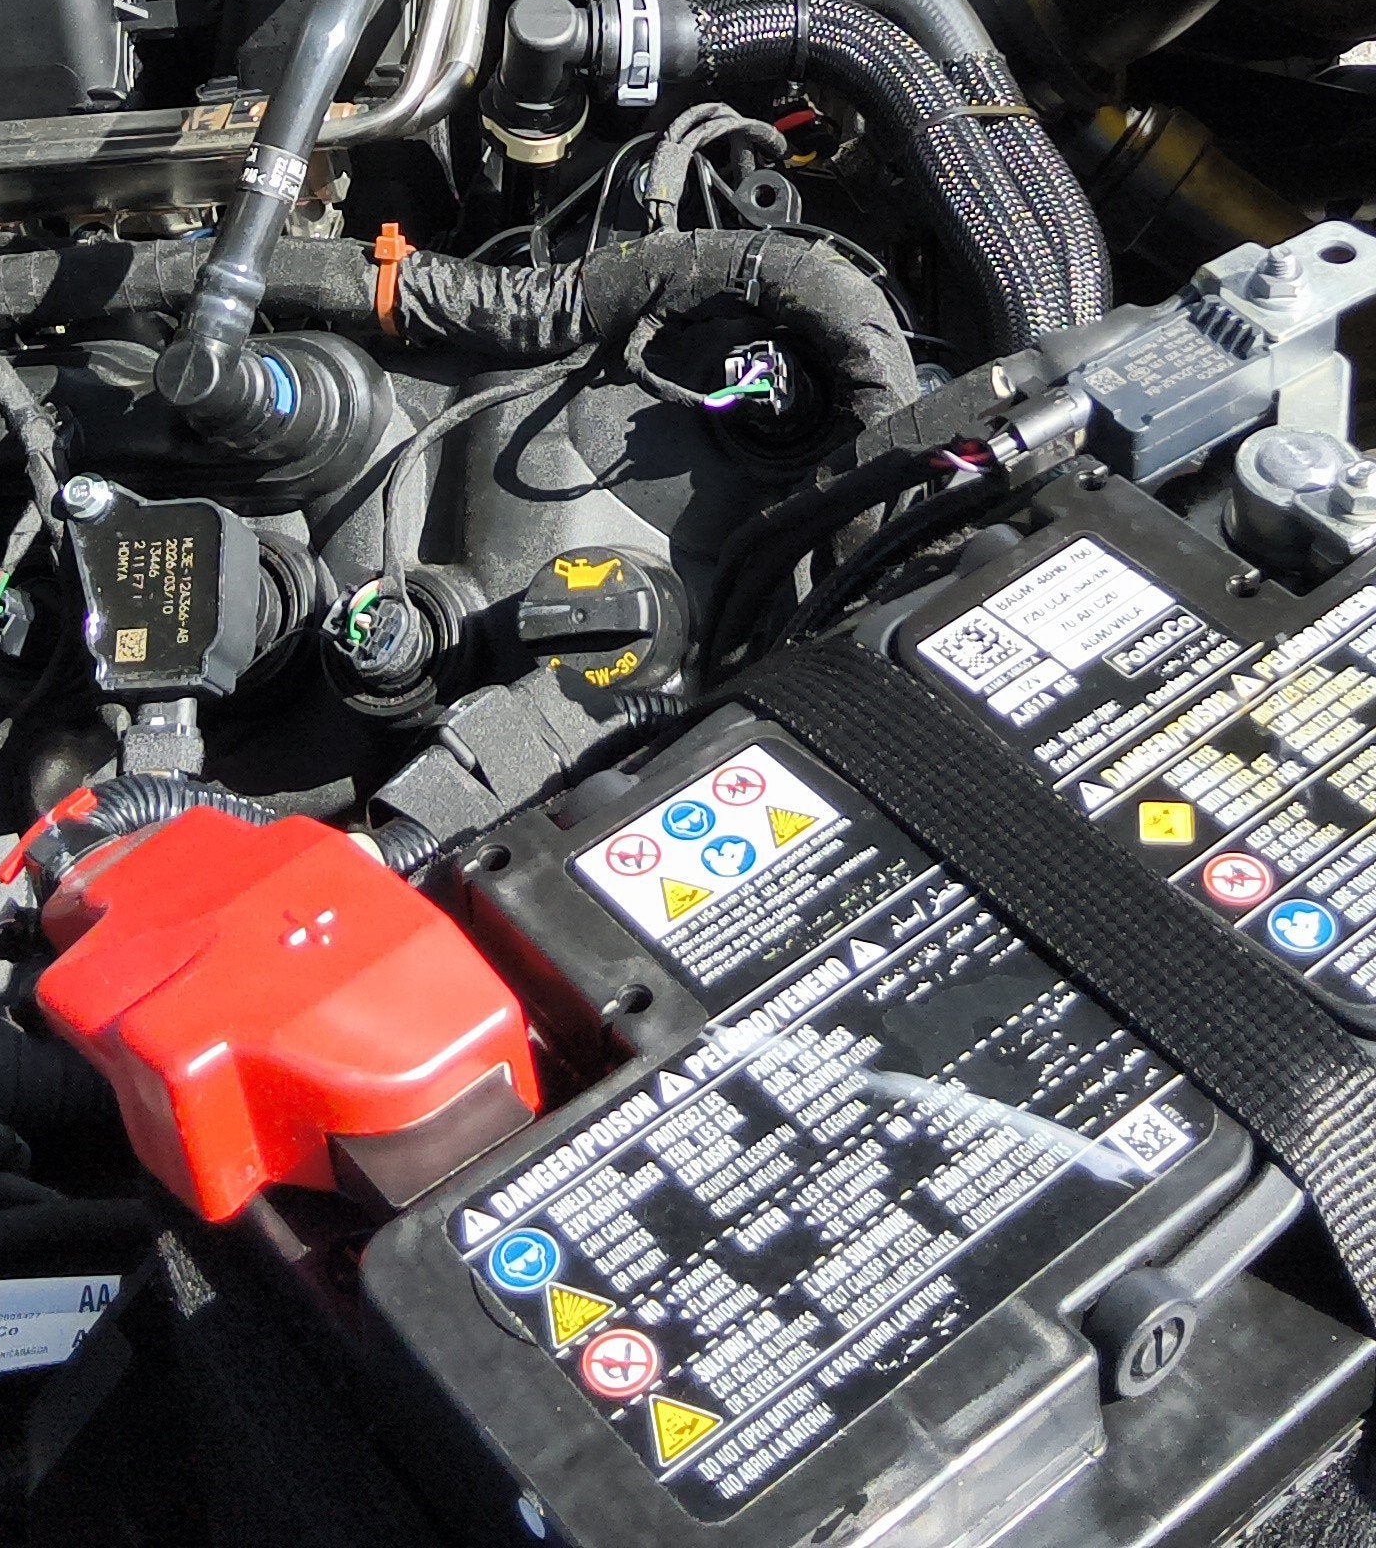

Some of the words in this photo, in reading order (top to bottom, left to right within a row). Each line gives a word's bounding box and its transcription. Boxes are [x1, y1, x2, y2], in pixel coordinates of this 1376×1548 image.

[1112, 608, 1198, 674] FoMoCo
[1007, 689, 1057, 727] AJ61A
[1052, 673, 1082, 696] MF
[1048, 749, 1082, 774] Ford
[1071, 729, 1110, 758] Motor
[1097, 688, 1241, 790] DANGER/POISON
[1354, 774, 1376, 790] LA
[1244, 824, 1277, 849] KEEP
[1267, 810, 1296, 831] OUT
[1286, 801, 1309, 817] OF
[1260, 841, 1287, 861] THE
[1276, 855, 1300, 873] OF
[1305, 867, 1340, 894] READ
[1329, 854, 1358, 875] ALL
[696, 904, 721, 923] USA
[1325, 885, 1358, 910] LIRE
[680, 954, 855, 1081] PELIGRO/VENENO
[789, 1023, 821, 1049] LOS
[775, 1057, 848, 1112] EXPLOSIVOS
[837, 1034, 882, 1068] PUEDEN
[790, 1048, 821, 1074] LOS
[809, 1023, 855, 1059] GASES
[692, 1120, 723, 1146] LES
[712, 1103, 746, 1131] GAZ
[697, 1090, 728, 1115] LES
[793, 1091, 839, 1128] CAUSAR
[883, 1114, 915, 1140] NO
[486, 1089, 664, 1220] DANGER/POISON
[674, 1133, 743, 1186] EXPLOSIFS
[733, 1133, 784, 1173] BLESSER
[773, 1122, 798, 1143] OU
[810, 1127, 829, 1144] O
[922, 1161, 969, 1200] ÁCIDO
[952, 1119, 1024, 1176] SULFÚRICO
[1025, 1140, 1074, 1179] FUERTES
[545, 1184, 595, 1224] SHIELD
[560, 1187, 629, 1241] EXPLOSIVE
[617, 1160, 666, 1199] GASES
[709, 1182, 755, 1219] RENDRE
[730, 1201, 791, 1251] ÉVITER
[795, 1181, 826, 1207] LES
[813, 1135, 885, 1192] ÉTINCELLES
[810, 1196, 840, 1222] LES
[830, 1158, 891, 1207] FLAMMES
[944, 1183, 982, 1215] PUEDE
[973, 1157, 1017, 1193] CAUSAR
[968, 1169, 1037, 1224] QUEMADURAS
[577, 1232, 608, 1259] CAN
[599, 1210, 639, 1243] CAUSE
[825, 1215, 850, 1237] DE
[841, 1186, 888, 1225] FUMER
[841, 1206, 917, 1267] SULFURIQUE
[960, 1214, 979, 1231] O
[593, 1226, 656, 1275] BLINDNESS
[79, 1283, 111, 1313] AA
[609, 1270, 634, 1292] OR
[636, 1297, 667, 1324] NO
[669, 1257, 723, 1300] SPARKS
[684, 1272, 738, 1316] FLAMES
[818, 1284, 853, 1314] PEUT
[843, 1256, 890, 1294] CAUSER
[879, 1246, 902, 1267] LA
[699, 1282, 760, 1332] SMOKING
[834, 1307, 859, 1330] OU
[849, 1292, 878, 1318] DES
[690, 1330, 755, 1383] SULFURIC
[744, 1308, 783, 1342] ACID
[708, 1373, 739, 1400] CAN
[729, 1348, 770, 1384] CAUSE
[760, 1309, 822, 1360] BLINDNESS
[815, 1365, 841, 1388] NE
[830, 1349, 861, 1376] PAS
[850, 1319, 898, 1360] OUVRIR
[886, 1307, 913, 1331] LA
[723, 1393, 749, 1416] OR
[739, 1365, 784, 1404] SEVERE
[696, 1455, 723, 1481] DO
[713, 1439, 745, 1467] NOT
[735, 1416, 773, 1450] OPEN
[734, 1446, 778, 1485] ABRIR
[767, 1435, 792, 1459] LA
